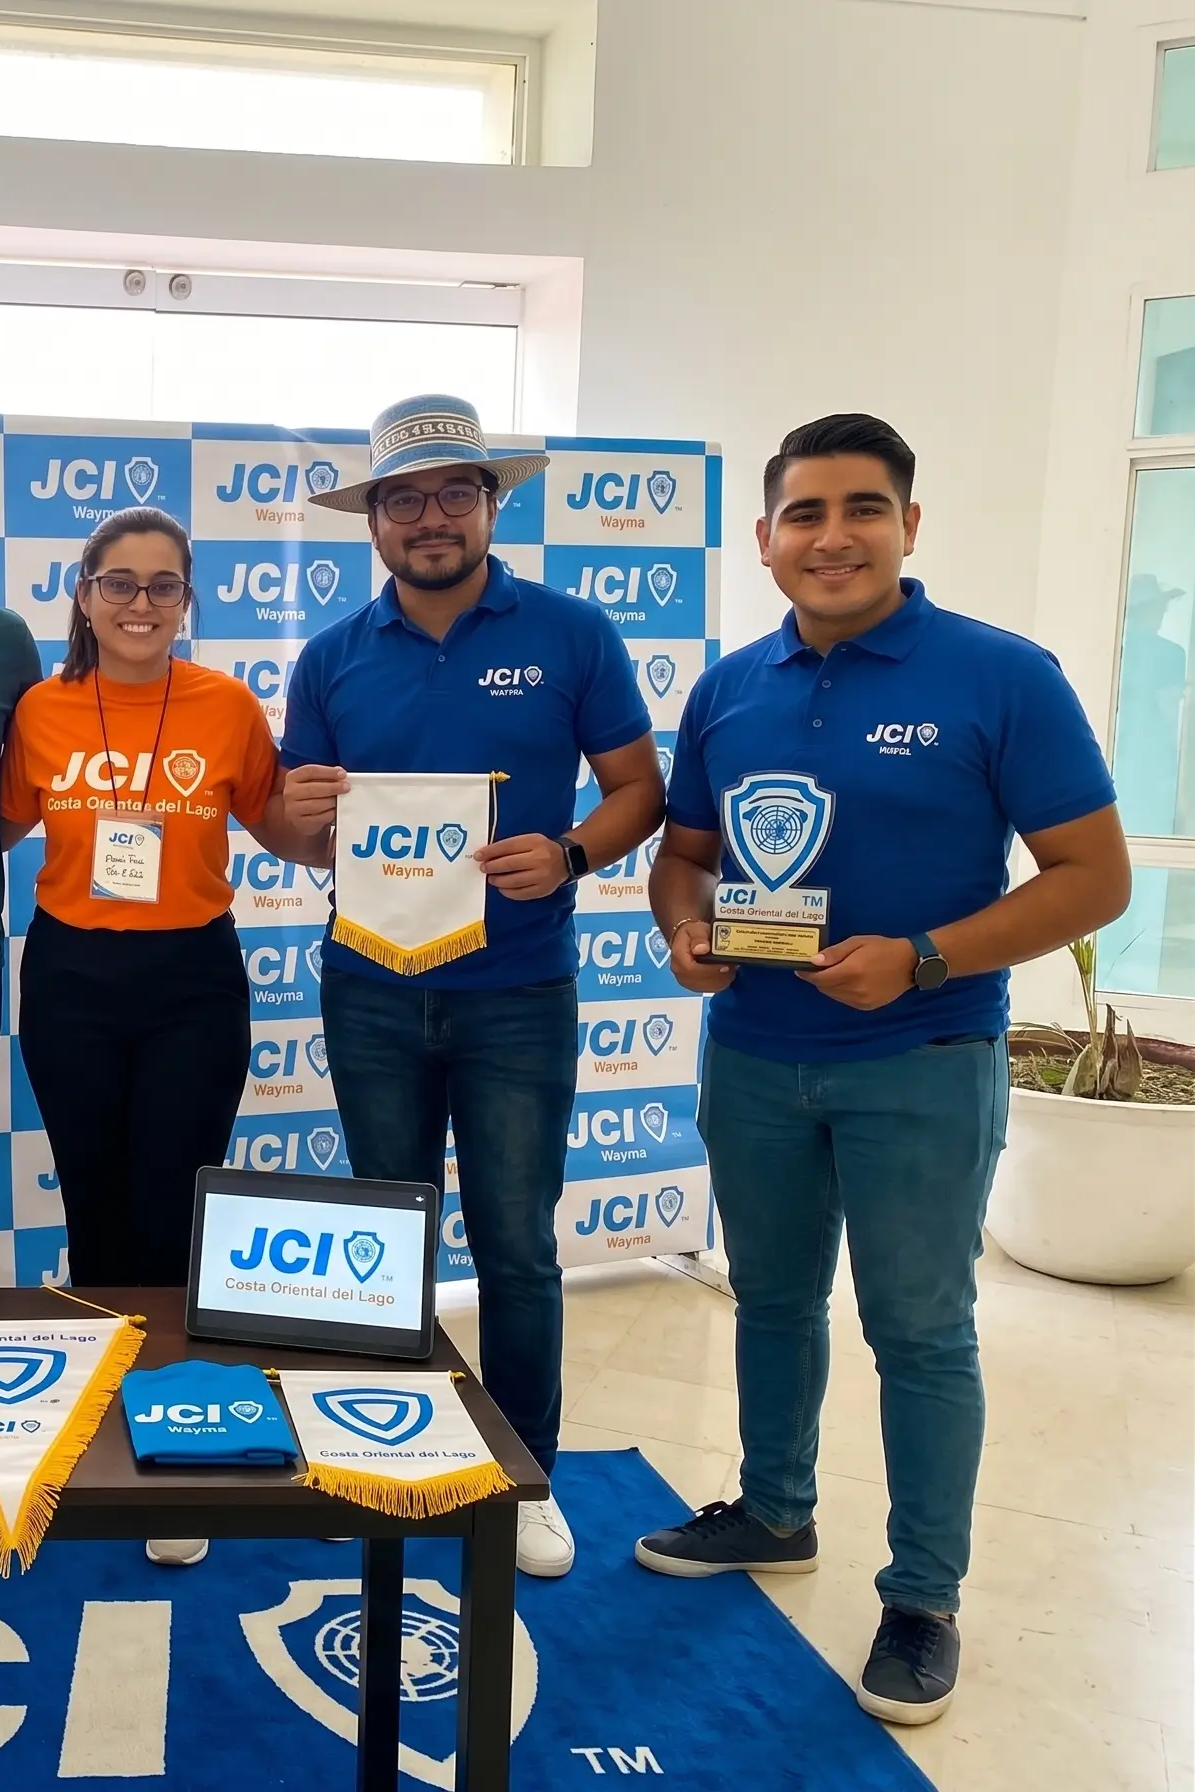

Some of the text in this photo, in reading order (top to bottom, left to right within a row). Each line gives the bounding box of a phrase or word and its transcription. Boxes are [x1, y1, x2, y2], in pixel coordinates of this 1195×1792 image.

[30, 458, 117, 501] JCI
[216, 463, 299, 503] JCI
[566, 472, 641, 511] JCI
[255, 508, 305, 525] Wayma
[600, 515, 645, 531] Wayma
[217, 563, 300, 604] JCI
[566, 566, 642, 604] JCI
[256, 607, 306, 624] Wayma
[478, 667, 522, 687] JCI
[866, 724, 915, 743] JCI
[50, 750, 154, 792] JCI
[47, 797, 82, 812] Costa
[156, 799, 181, 813] del
[186, 801, 218, 820] Lago
[108, 832, 134, 845] JCI
[351, 825, 429, 860] JCI
[382, 863, 434, 879] Wayma
[598, 884, 644, 898] Wayma
[719, 888, 823, 908] JCI TM
[253, 895, 303, 910] Wayma
[719, 906, 745, 916] Costa
[747, 907, 783, 918] Oriental
[785, 910, 799, 919] del
[598, 973, 642, 987] Wayma
[254, 990, 304, 1005] Wayma
[594, 1061, 638, 1075] Wayma
[253, 1083, 303, 1098] Wayma
[567, 1108, 636, 1149] JCI
[601, 1148, 647, 1163] Wayma
[575, 1193, 649, 1236] JCI
[606, 1234, 651, 1250] Wayma
[229, 1227, 394, 1283] JCI TM
[225, 1277, 395, 1307] Costa Oriental del Lago
[32, 1334, 55, 1342] del
[60, 1334, 97, 1343] Lago
[134, 1403, 221, 1424] JCI
[167, 1425, 227, 1435] Wayma
[363, 1450, 415, 1459] Oriental
[443, 1450, 476, 1460] Lago
[570, 1746, 665, 1774] TM
